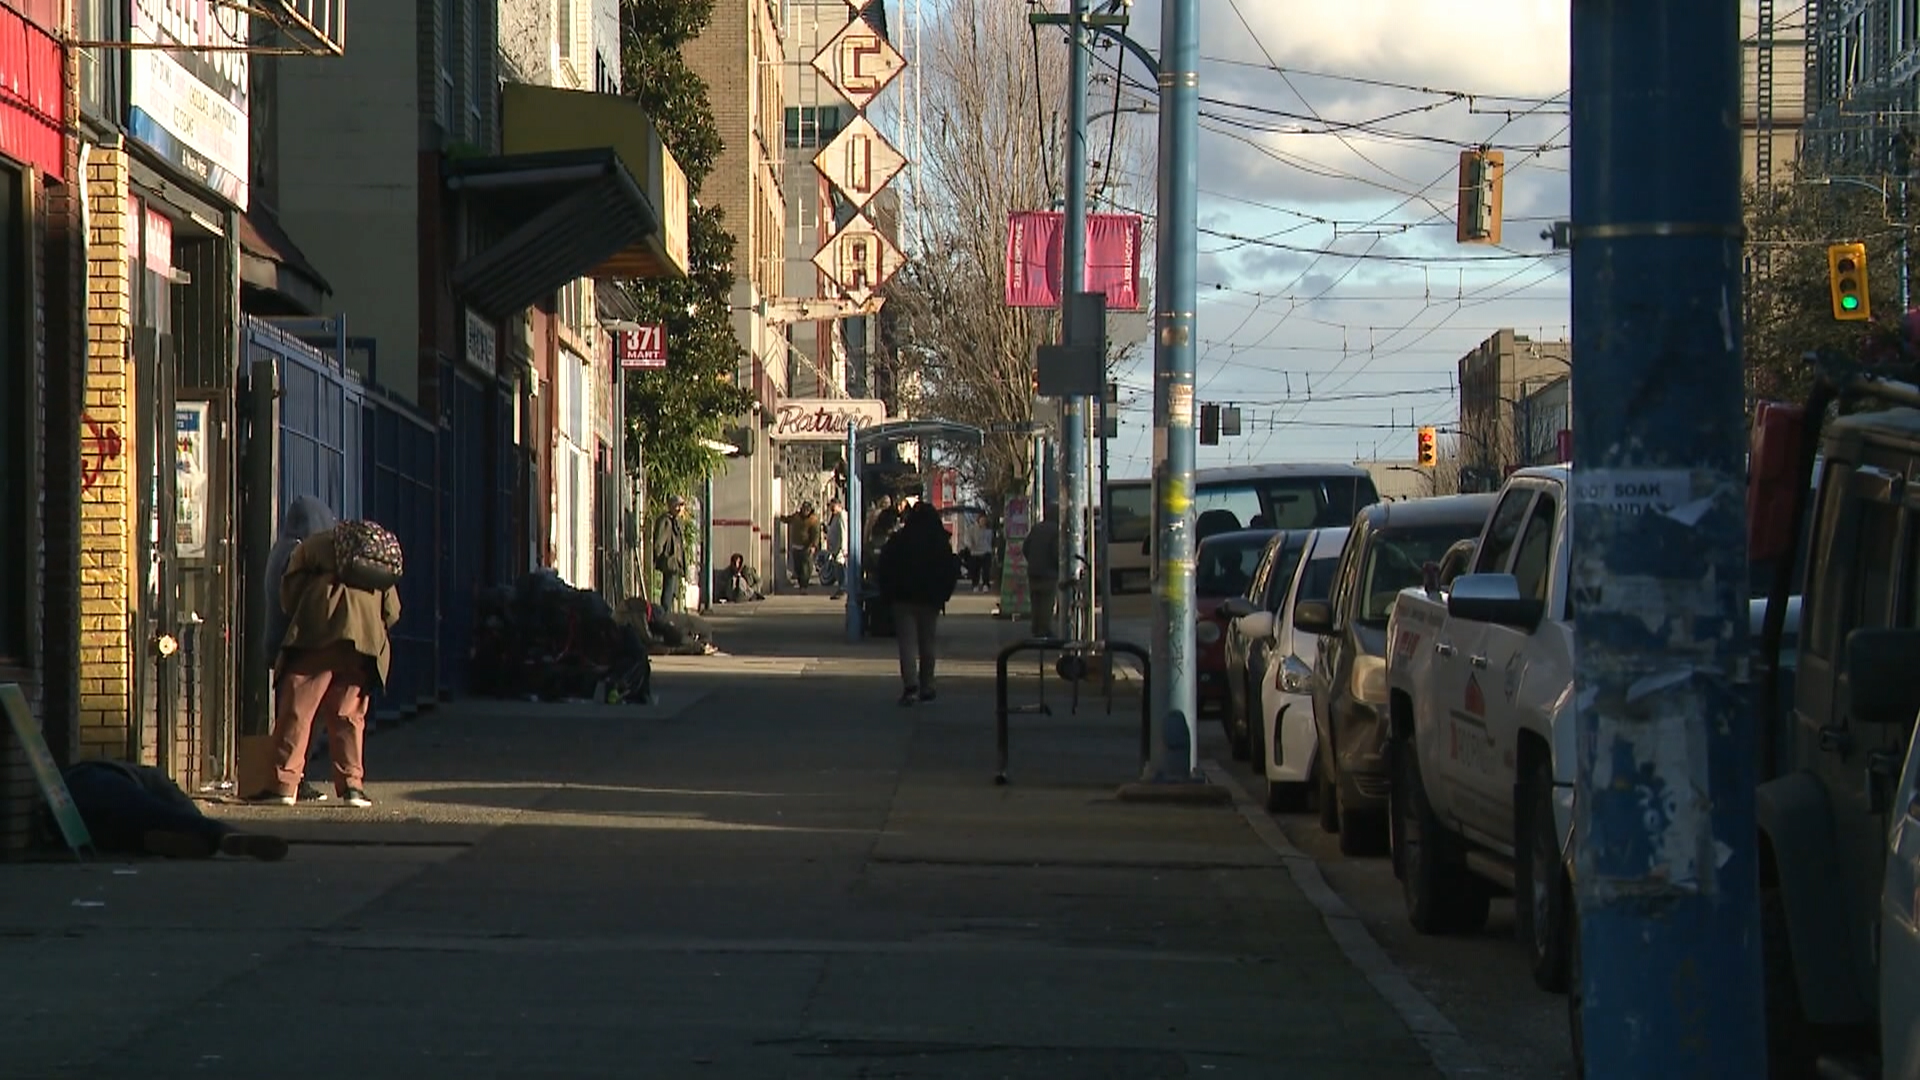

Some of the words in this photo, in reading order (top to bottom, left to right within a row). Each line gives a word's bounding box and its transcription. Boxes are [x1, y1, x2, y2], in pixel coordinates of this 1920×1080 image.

[626, 326, 661, 351] 371
[627, 351, 661, 359] MART
[1614, 482, 1661, 498] SOAK
